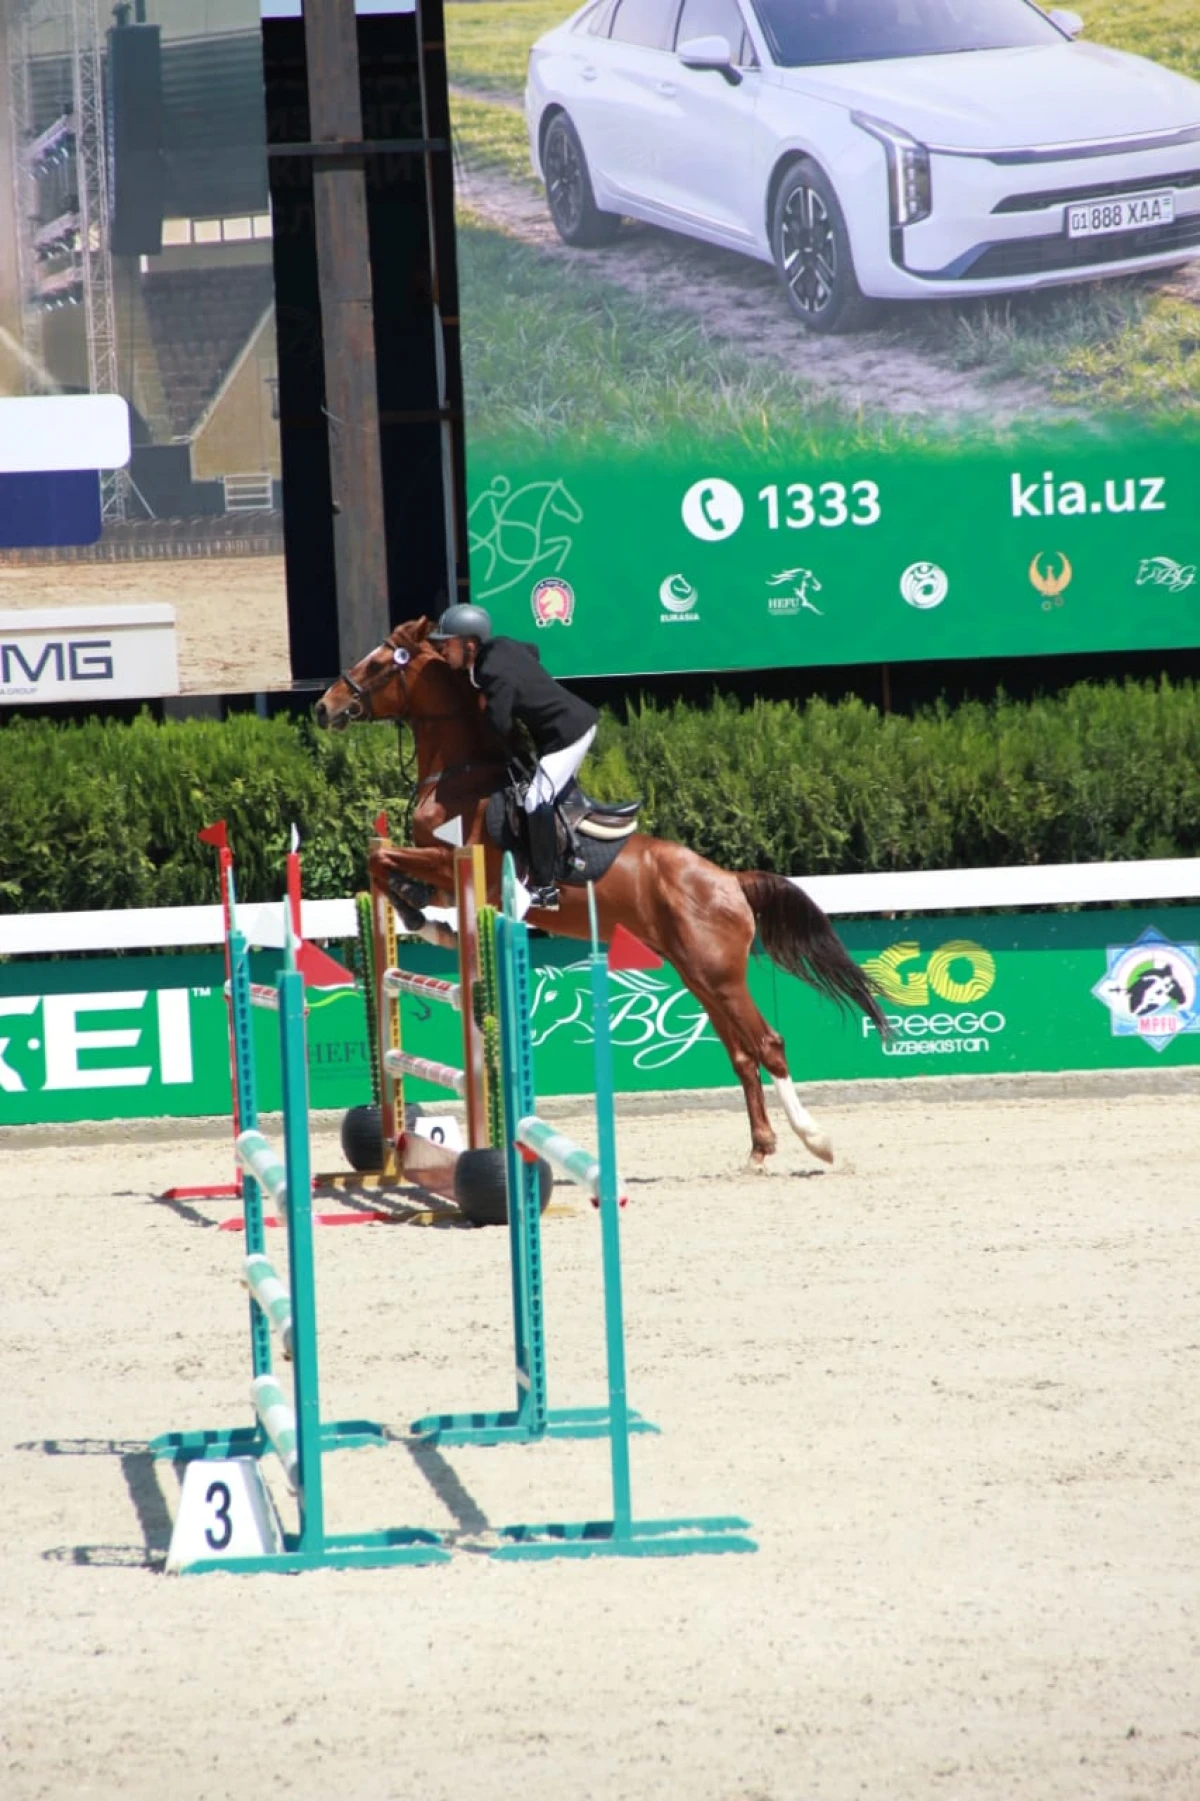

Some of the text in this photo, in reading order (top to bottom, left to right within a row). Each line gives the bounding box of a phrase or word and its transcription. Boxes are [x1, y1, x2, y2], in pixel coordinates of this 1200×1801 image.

[1091, 205, 1122, 230] 888
[1127, 199, 1161, 224] XAA
[758, 480, 882, 529] 1333
[1010, 471, 1167, 518] kia.uz
[660, 612, 700, 622] EURASIA
[860, 939, 996, 1006] GO
[204, 1480, 233, 1551] 3
